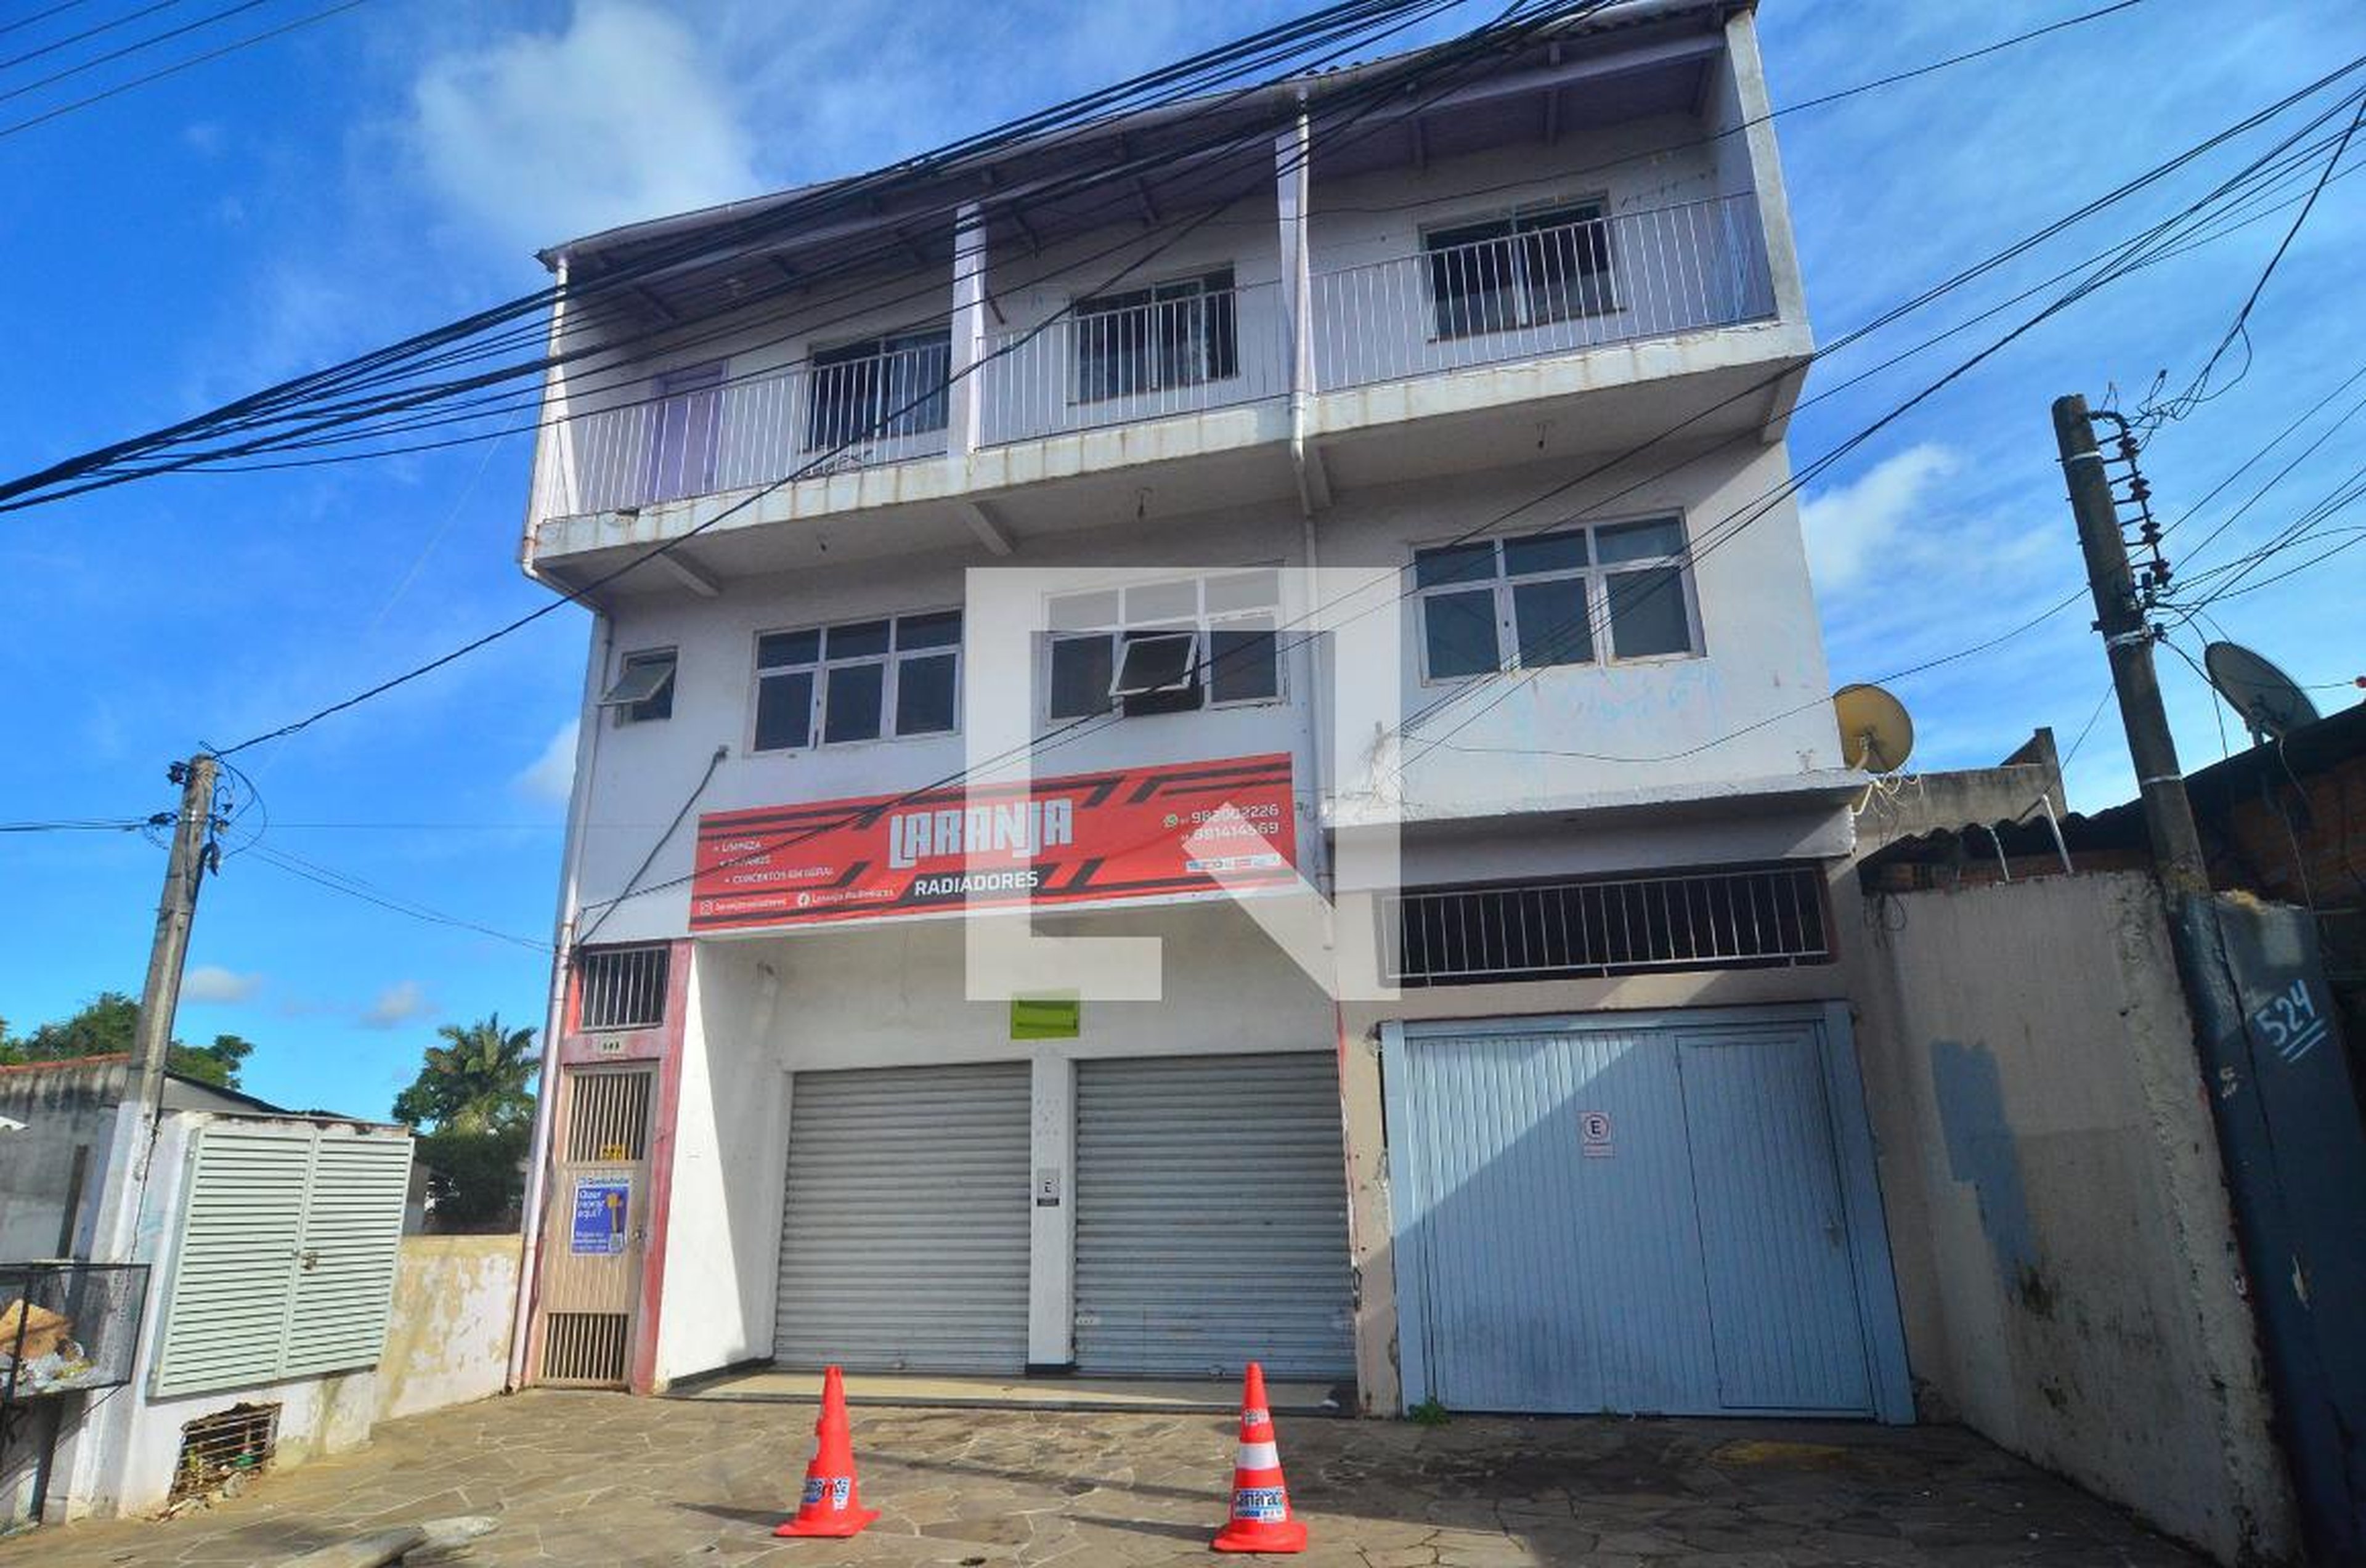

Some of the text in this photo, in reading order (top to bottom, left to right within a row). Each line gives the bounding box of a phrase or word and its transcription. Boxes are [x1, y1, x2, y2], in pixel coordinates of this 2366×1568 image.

[889, 798, 1072, 869] LARANJA
[914, 871, 1039, 896] RADIADORES
[2254, 979, 2315, 1046] 524
[1590, 1119, 1601, 1135] E
